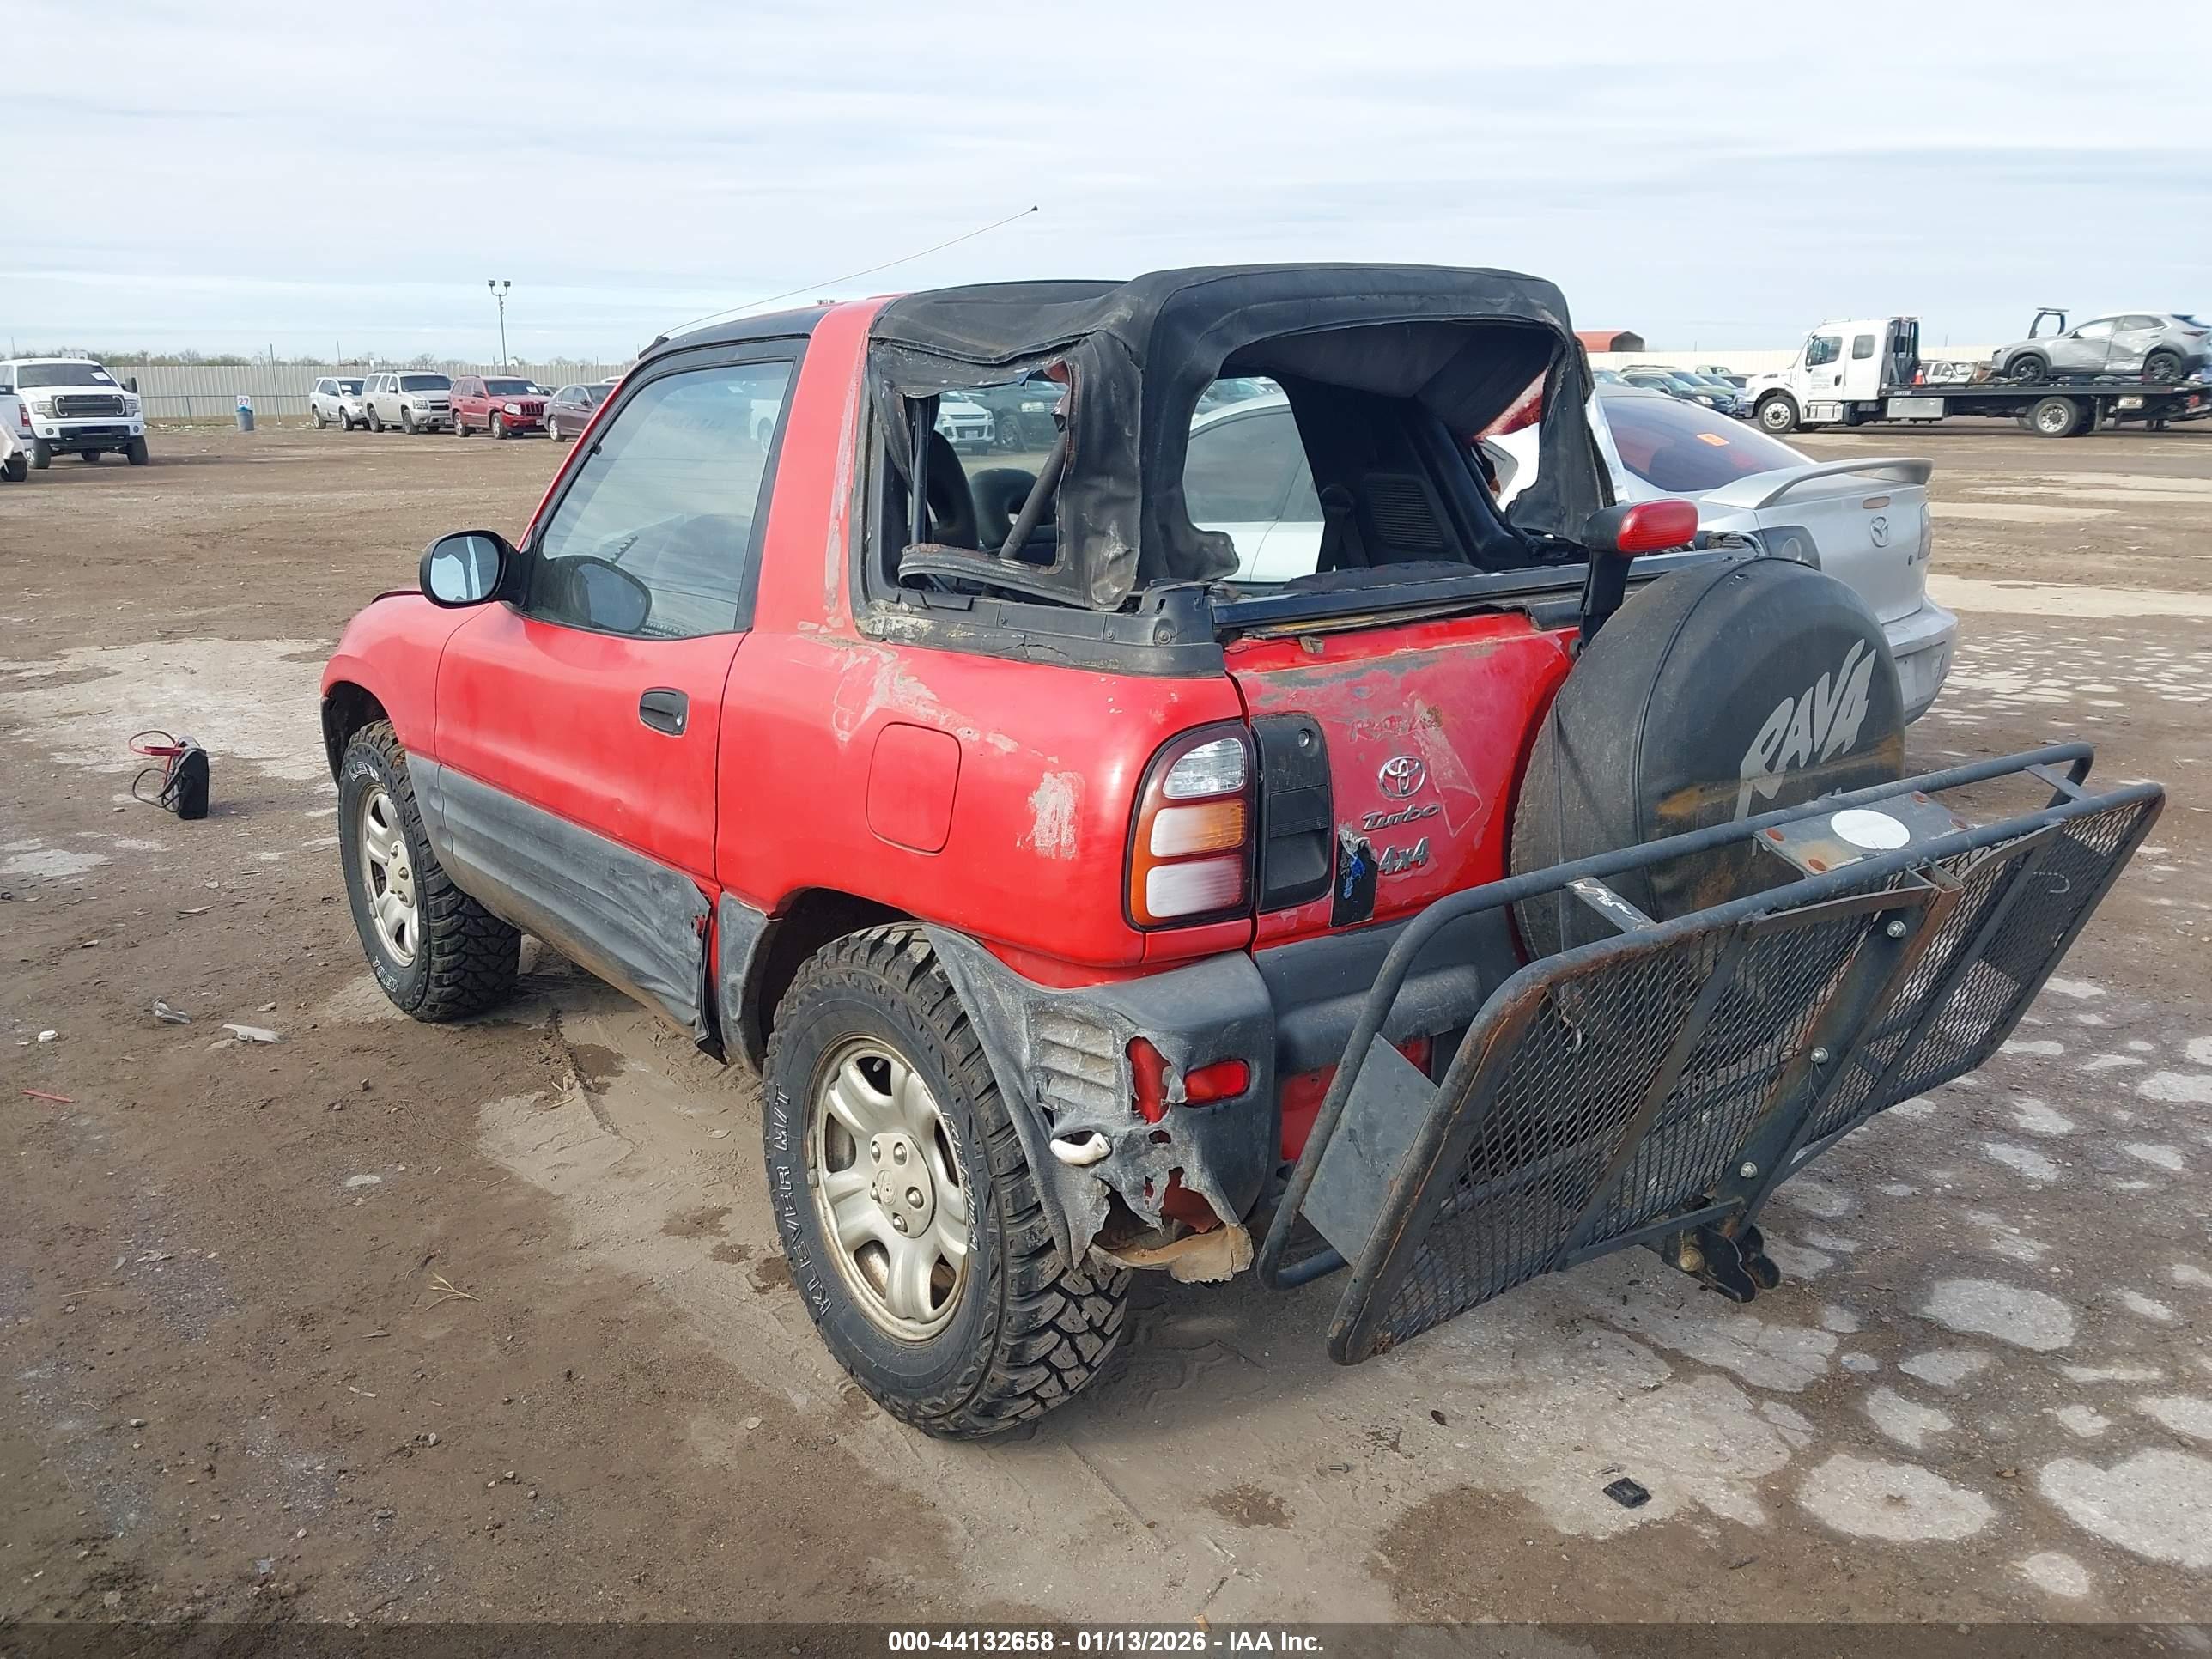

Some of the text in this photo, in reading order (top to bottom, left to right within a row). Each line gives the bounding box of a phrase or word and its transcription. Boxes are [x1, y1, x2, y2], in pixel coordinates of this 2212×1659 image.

[239, 398, 249, 406] 27
[1362, 804, 1440, 830] Turbo
[1378, 836, 1430, 875] 4x4
[776, 1165, 833, 1316] KLEVER
